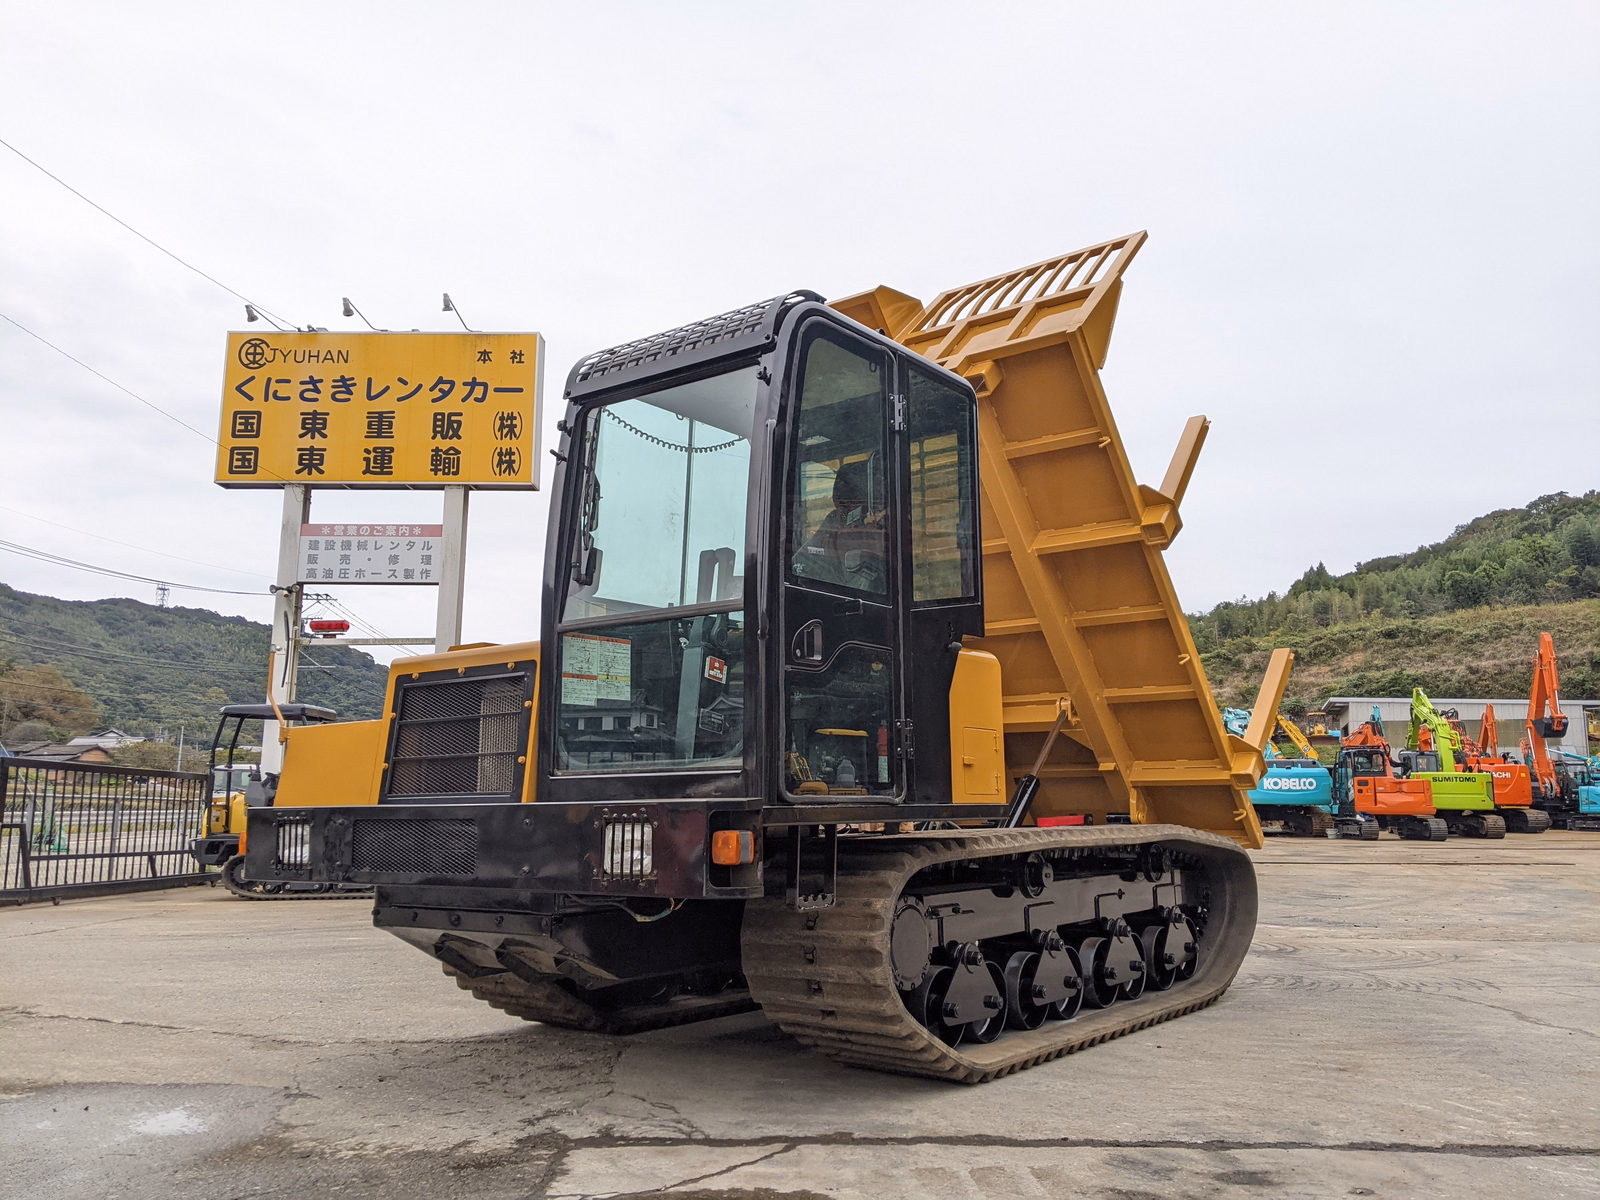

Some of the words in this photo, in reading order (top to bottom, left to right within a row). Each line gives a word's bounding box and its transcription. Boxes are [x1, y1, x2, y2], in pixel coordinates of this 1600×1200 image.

[264, 348, 350, 364] JYUHAN
[477, 349, 525, 364] 本社
[235, 375, 524, 403] くにさきレンタカー
[308, 540, 433, 551] 建設機械レンタル
[305, 568, 432, 580] 高油圧ホース製作
[1263, 778, 1317, 790] KOBELCO
